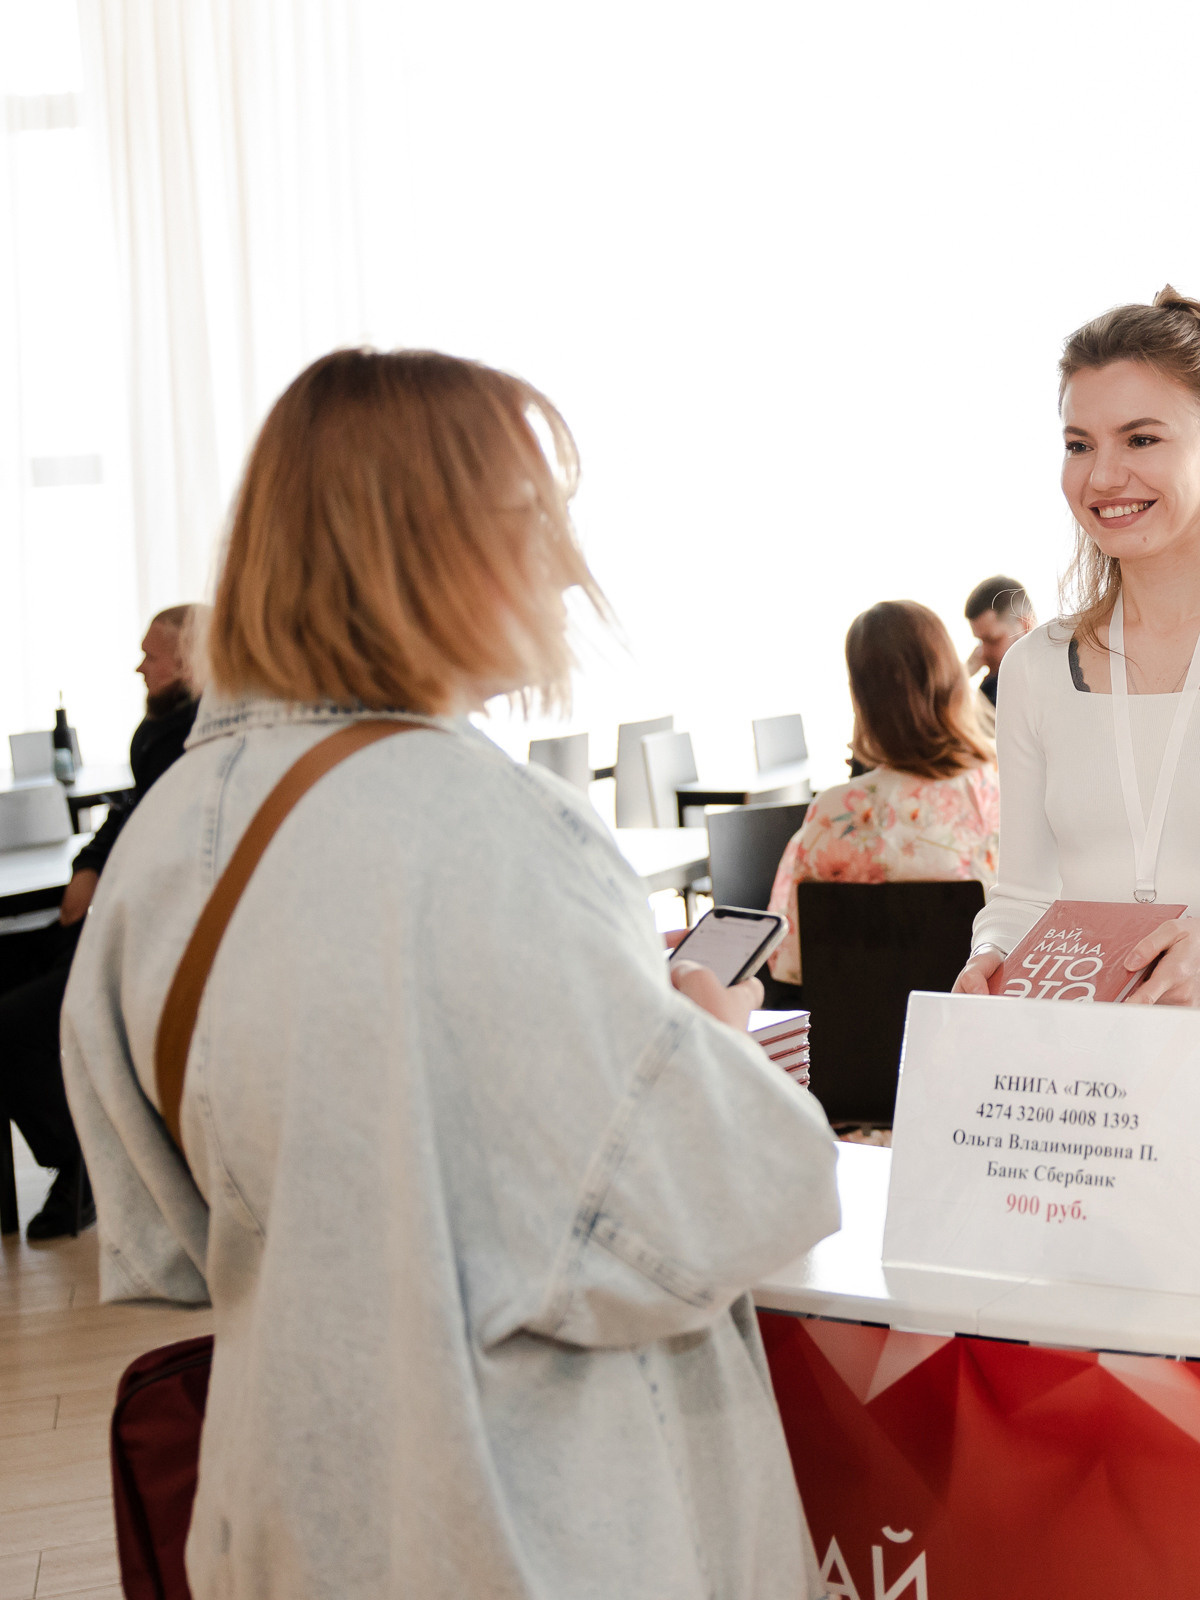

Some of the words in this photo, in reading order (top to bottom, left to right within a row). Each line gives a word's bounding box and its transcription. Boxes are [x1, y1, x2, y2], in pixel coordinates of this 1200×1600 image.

[1043, 927, 1082, 941] ВАЙ,
[1033, 941, 1106, 958] МАМА,
[1021, 954, 1104, 982] ЧТО
[1003, 978, 1096, 1003] ЭТО
[993, 1074, 1058, 1095] КНИГА
[1063, 1080, 1127, 1100] «ГЖО»
[976, 1103, 1013, 1120] 4274
[1016, 1105, 1054, 1124] 3200
[1059, 1107, 1096, 1127] 4008
[1102, 1111, 1139, 1130] 1393
[952, 1128, 1003, 1150] Ольга
[1008, 1133, 1134, 1161] Владимировна
[1138, 1144, 1159, 1163] П.
[986, 1161, 1029, 1181] Банк
[1033, 1165, 1117, 1189] Сбербанк
[1006, 1193, 1041, 1216] 900
[1045, 1199, 1087, 1223] руб.
[819, 1526, 929, 1600] АЙ
